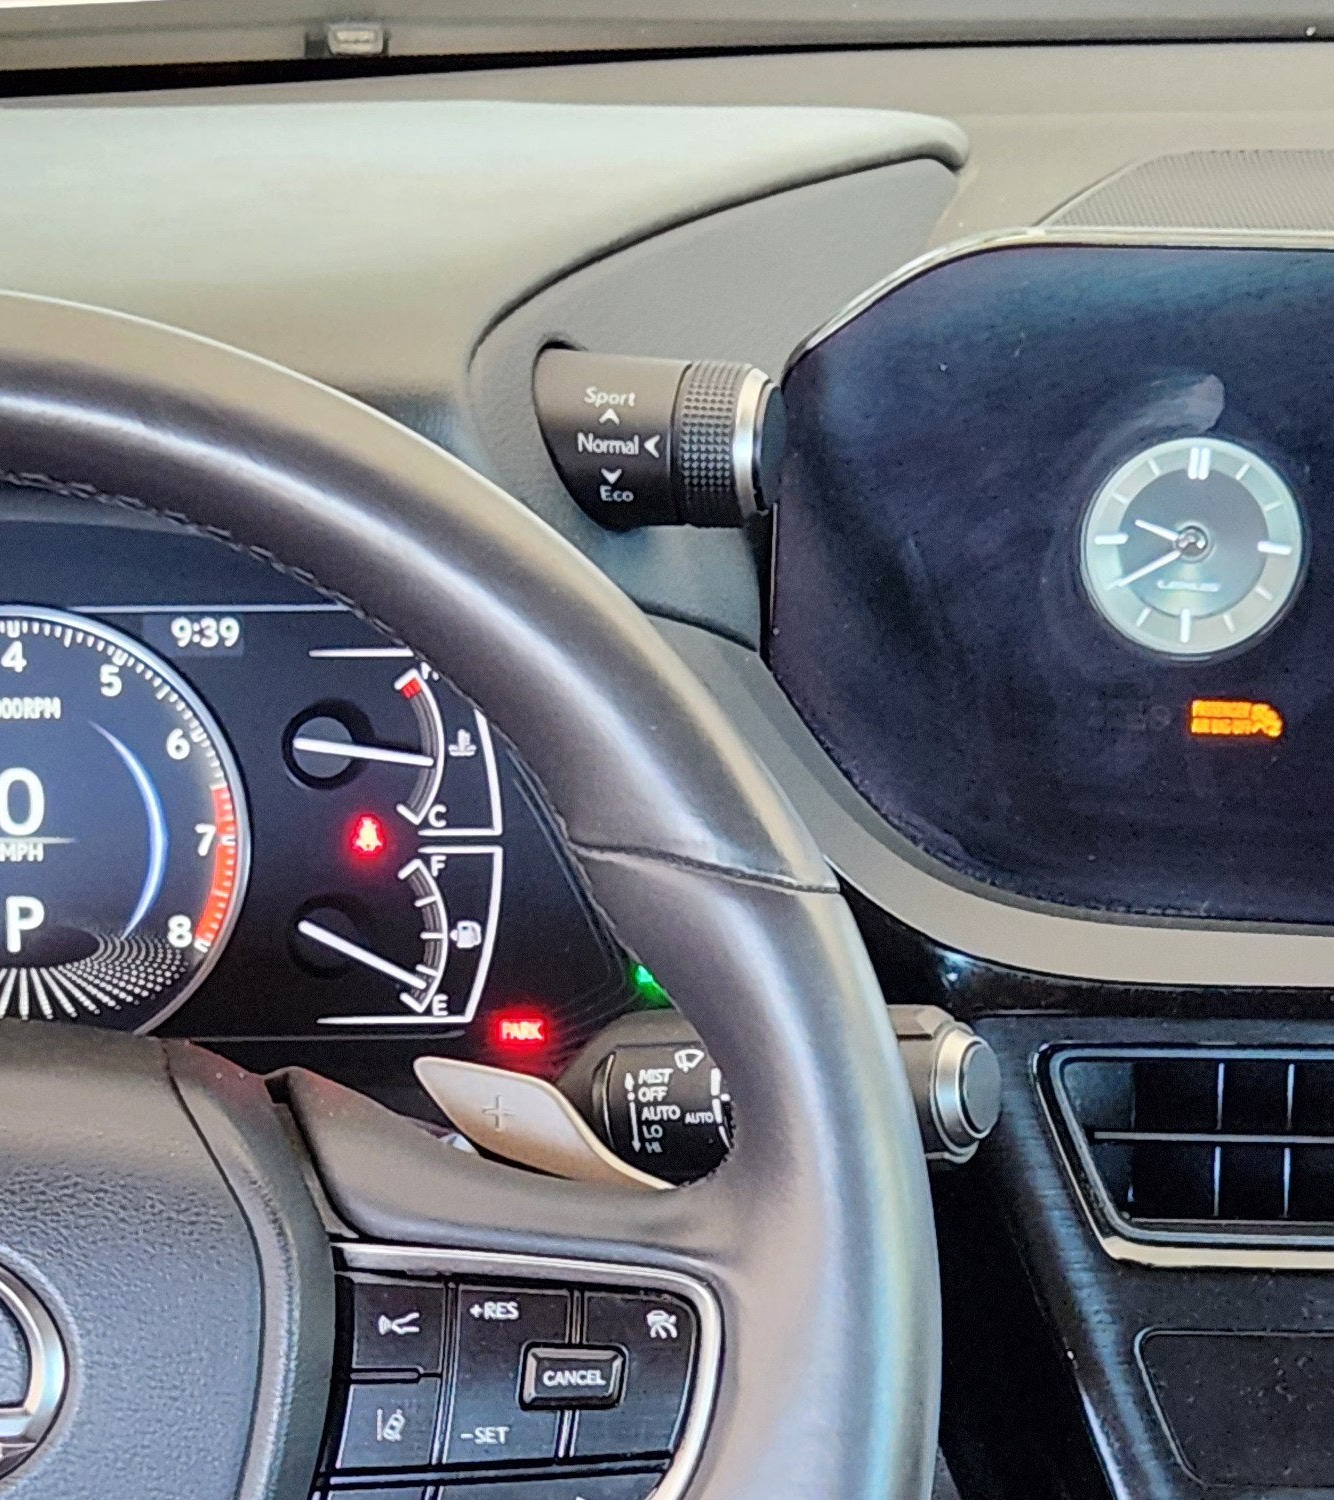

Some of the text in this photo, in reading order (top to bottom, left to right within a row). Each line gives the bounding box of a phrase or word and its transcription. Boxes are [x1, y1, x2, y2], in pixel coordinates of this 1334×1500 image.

[584, 385, 636, 408] Sport
[577, 432, 639, 455] Normal
[599, 485, 634, 502] Eco
[171, 617, 241, 648] 9:39
[0, 640, 27, 672] 4
[99, 665, 123, 698] 5
[166, 734, 191, 761] 6
[428, 804, 447, 828] C
[195, 824, 217, 857] 7
[430, 855, 447, 877] F
[4, 894, 45, 954] P
[168, 913, 193, 948] 8
[432, 993, 449, 1017] E
[500, 1020, 544, 1041] PARK
[638, 1068, 674, 1085] MIST
[637, 1086, 669, 1103] OFF
[641, 1105, 681, 1121] AUTO
[684, 1111, 714, 1125] AUTO
[642, 1124, 664, 1140] LO
[542, 1369, 607, 1387] CANCEL
